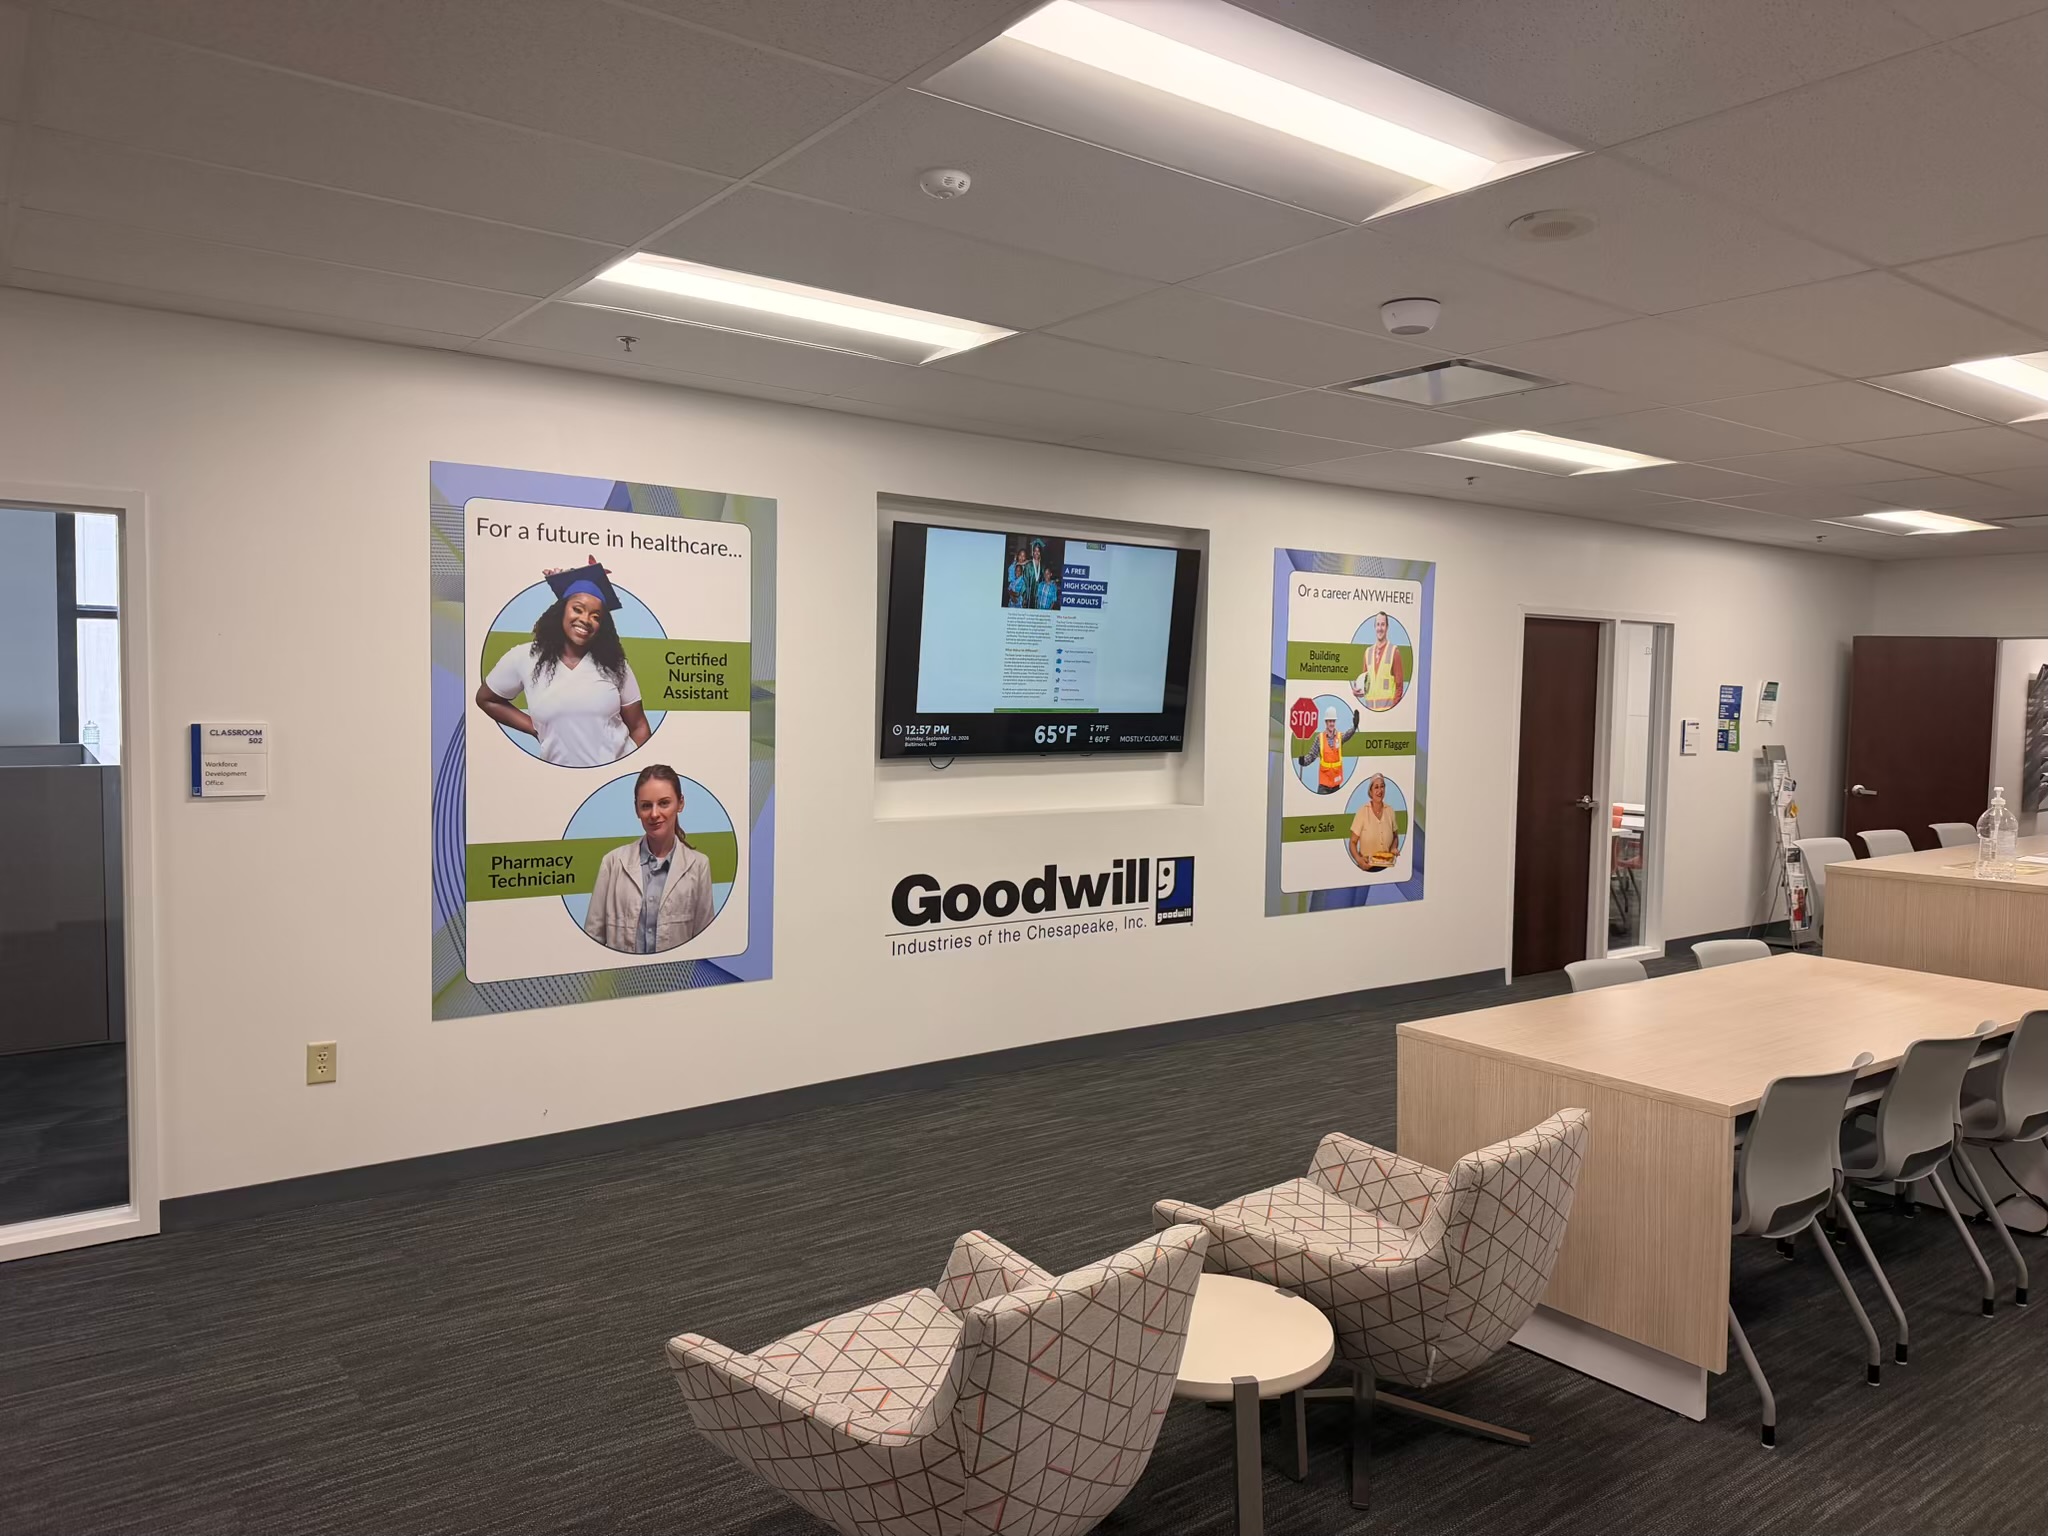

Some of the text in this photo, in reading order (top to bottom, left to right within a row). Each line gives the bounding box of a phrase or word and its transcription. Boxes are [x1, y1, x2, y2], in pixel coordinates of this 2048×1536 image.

[476, 517, 743, 558] For a future in healthcare...
[1071, 568, 1086, 576] FREE
[1064, 582, 1104, 592] HIGH SCHOOL
[1298, 584, 1414, 604] Or a career ANYWHERE!
[1063, 596, 1099, 606] FOR ADULTS
[665, 651, 728, 667] Certified
[1309, 650, 1340, 662] Building
[1300, 663, 1349, 673] Maintenance
[668, 669, 725, 686] Nursing
[663, 686, 729, 700] Assistant
[1291, 710, 1318, 727] STOP
[905, 725, 950, 735] 12:57 PM
[1034, 725, 1078, 744] 65°F
[1366, 739, 1410, 750] DOT Flagger
[1300, 822, 1335, 834] Serv Safe
[491, 855, 574, 871] Pharmacy
[488, 871, 576, 889] Technician
[891, 858, 1150, 927] Goodwill
[1157, 908, 1192, 923] goodwill
[892, 915, 1148, 956] Industries of the Chesapeake, Inc.
